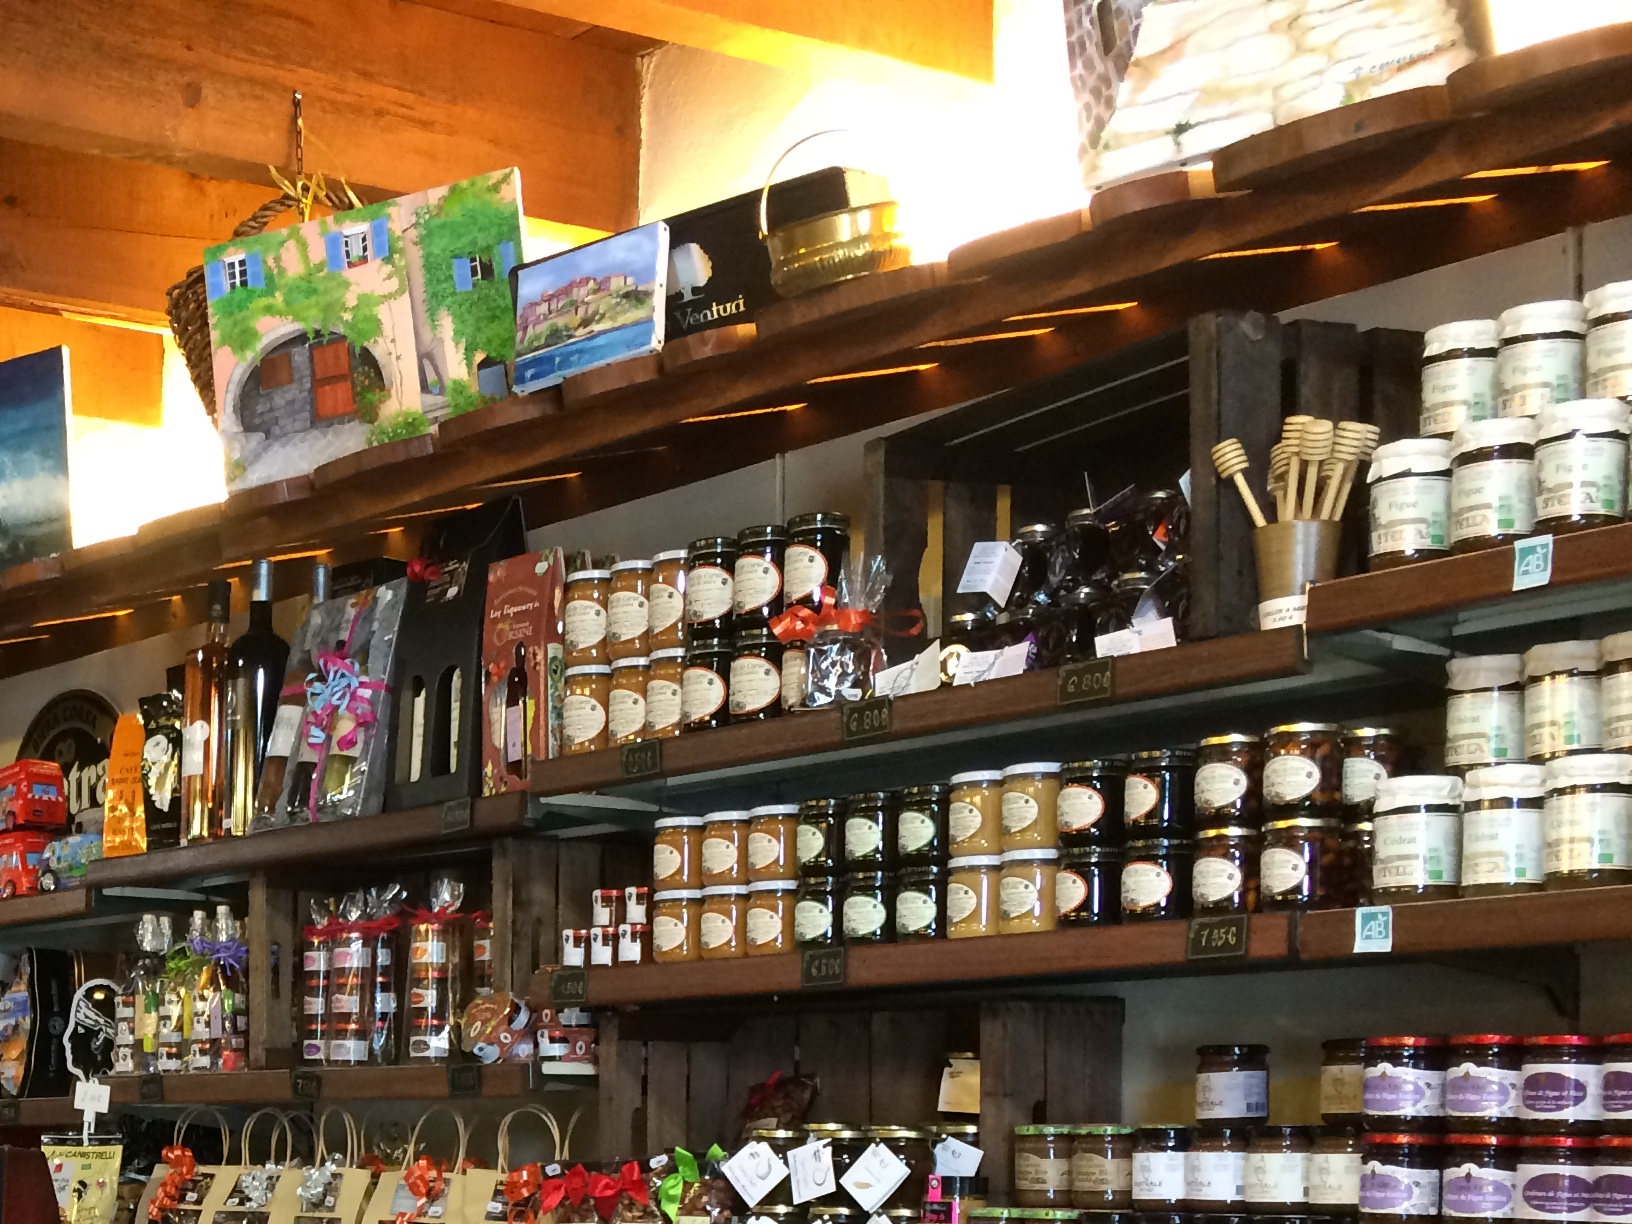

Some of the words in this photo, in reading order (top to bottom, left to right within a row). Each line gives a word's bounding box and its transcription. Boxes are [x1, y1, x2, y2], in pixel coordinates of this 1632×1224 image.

[674, 294, 746, 331] Venturi
[1512, 363, 1542, 375] Figue
[1432, 383, 1458, 395] Figue
[1388, 500, 1418, 512] Figue
[1520, 550, 1547, 576] AB
[1362, 917, 1387, 940] AB
